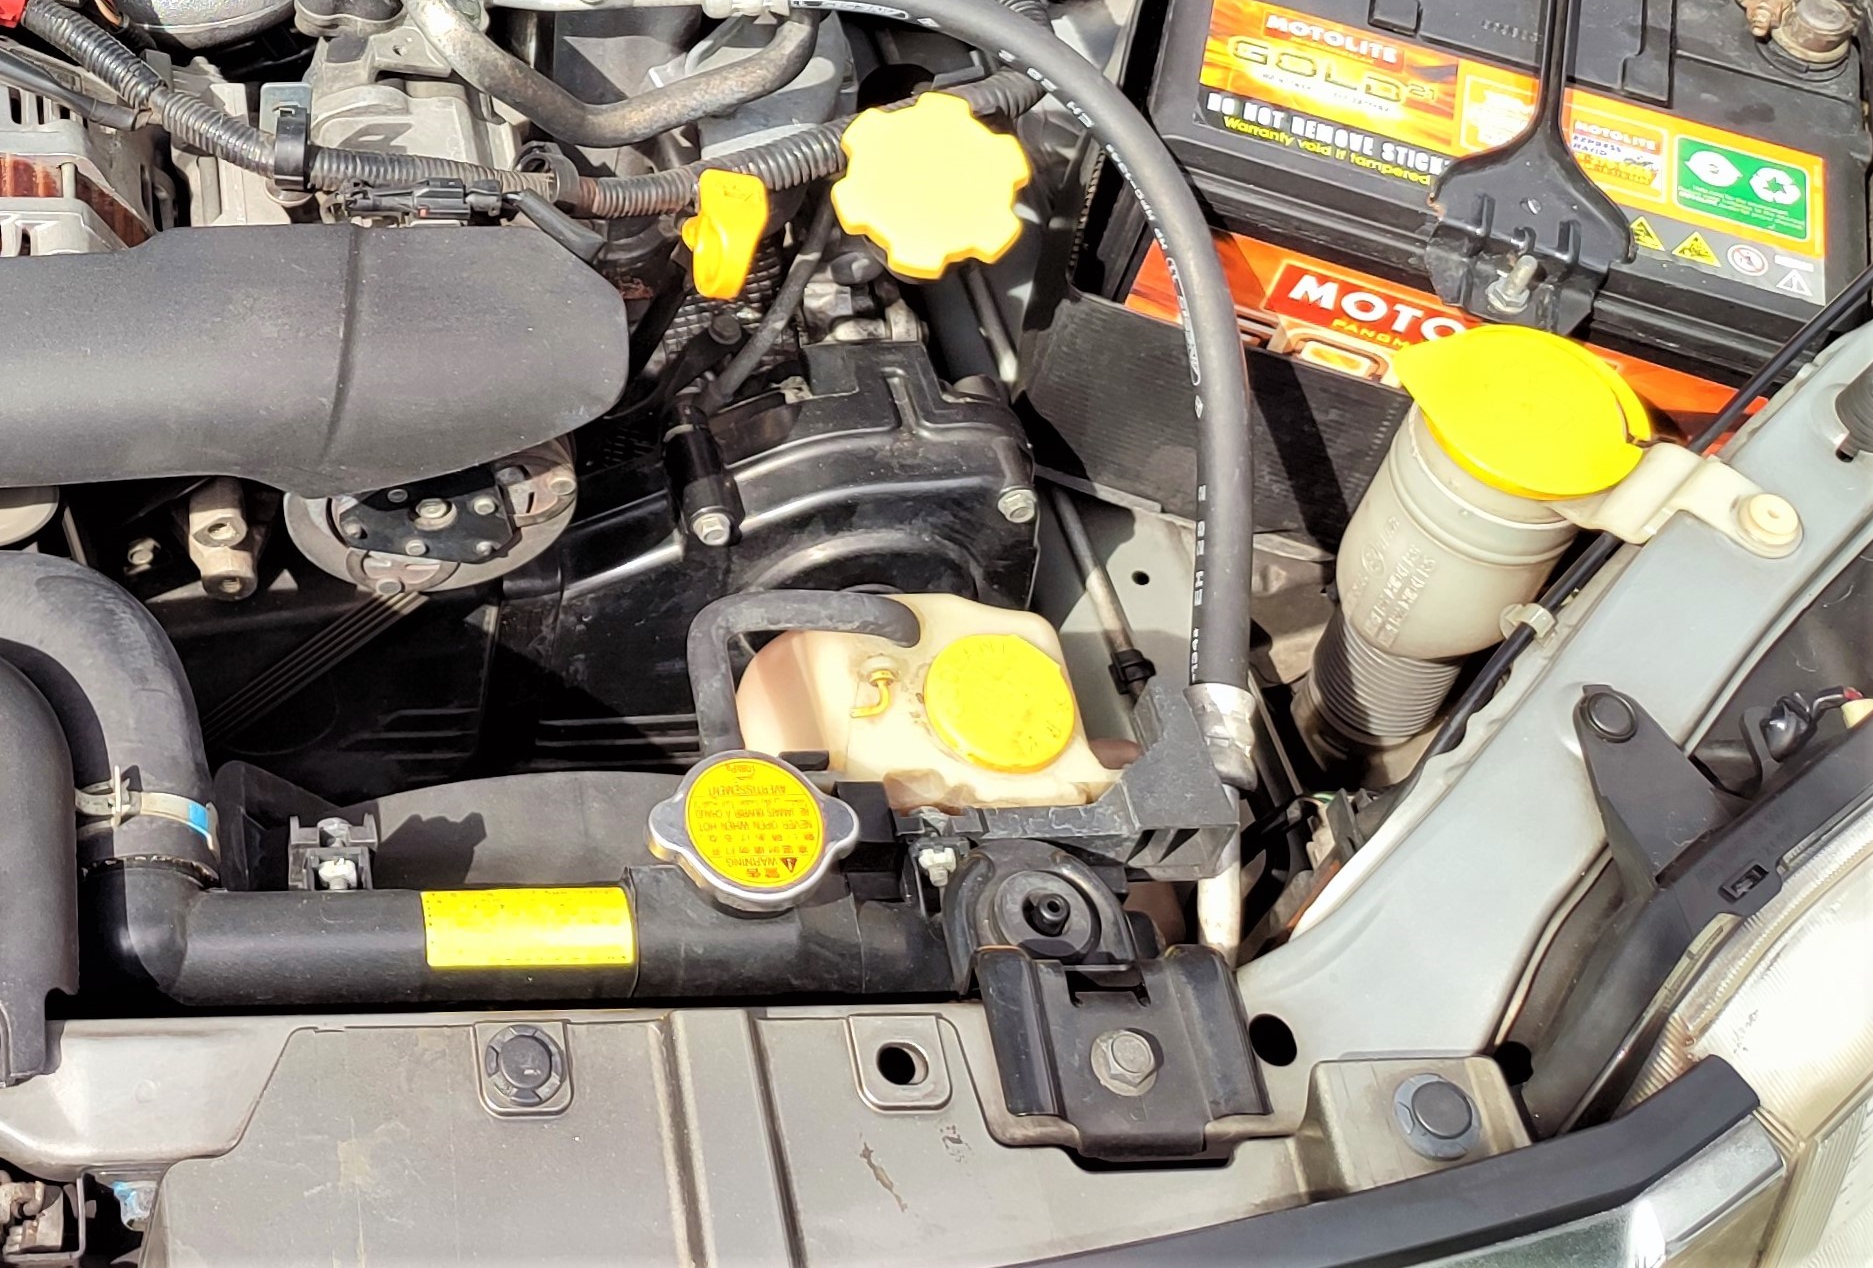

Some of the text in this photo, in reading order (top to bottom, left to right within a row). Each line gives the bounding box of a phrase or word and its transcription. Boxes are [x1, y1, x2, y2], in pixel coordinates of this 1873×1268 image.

[1265, 15, 1398, 64] MOTOLITE
[1206, 92, 1450, 176] DO NOT REMOVE STICK
[1223, 115, 1431, 186] Warranty void if tampered
[1574, 121, 1658, 151] MOTOLITE
[1287, 274, 1468, 343] MOTO
[707, 784, 786, 797] AVERTISSEMENT
[699, 819, 813, 832] NEVER OPEN WHEN HOT
[725, 857, 778, 868] WARNING
